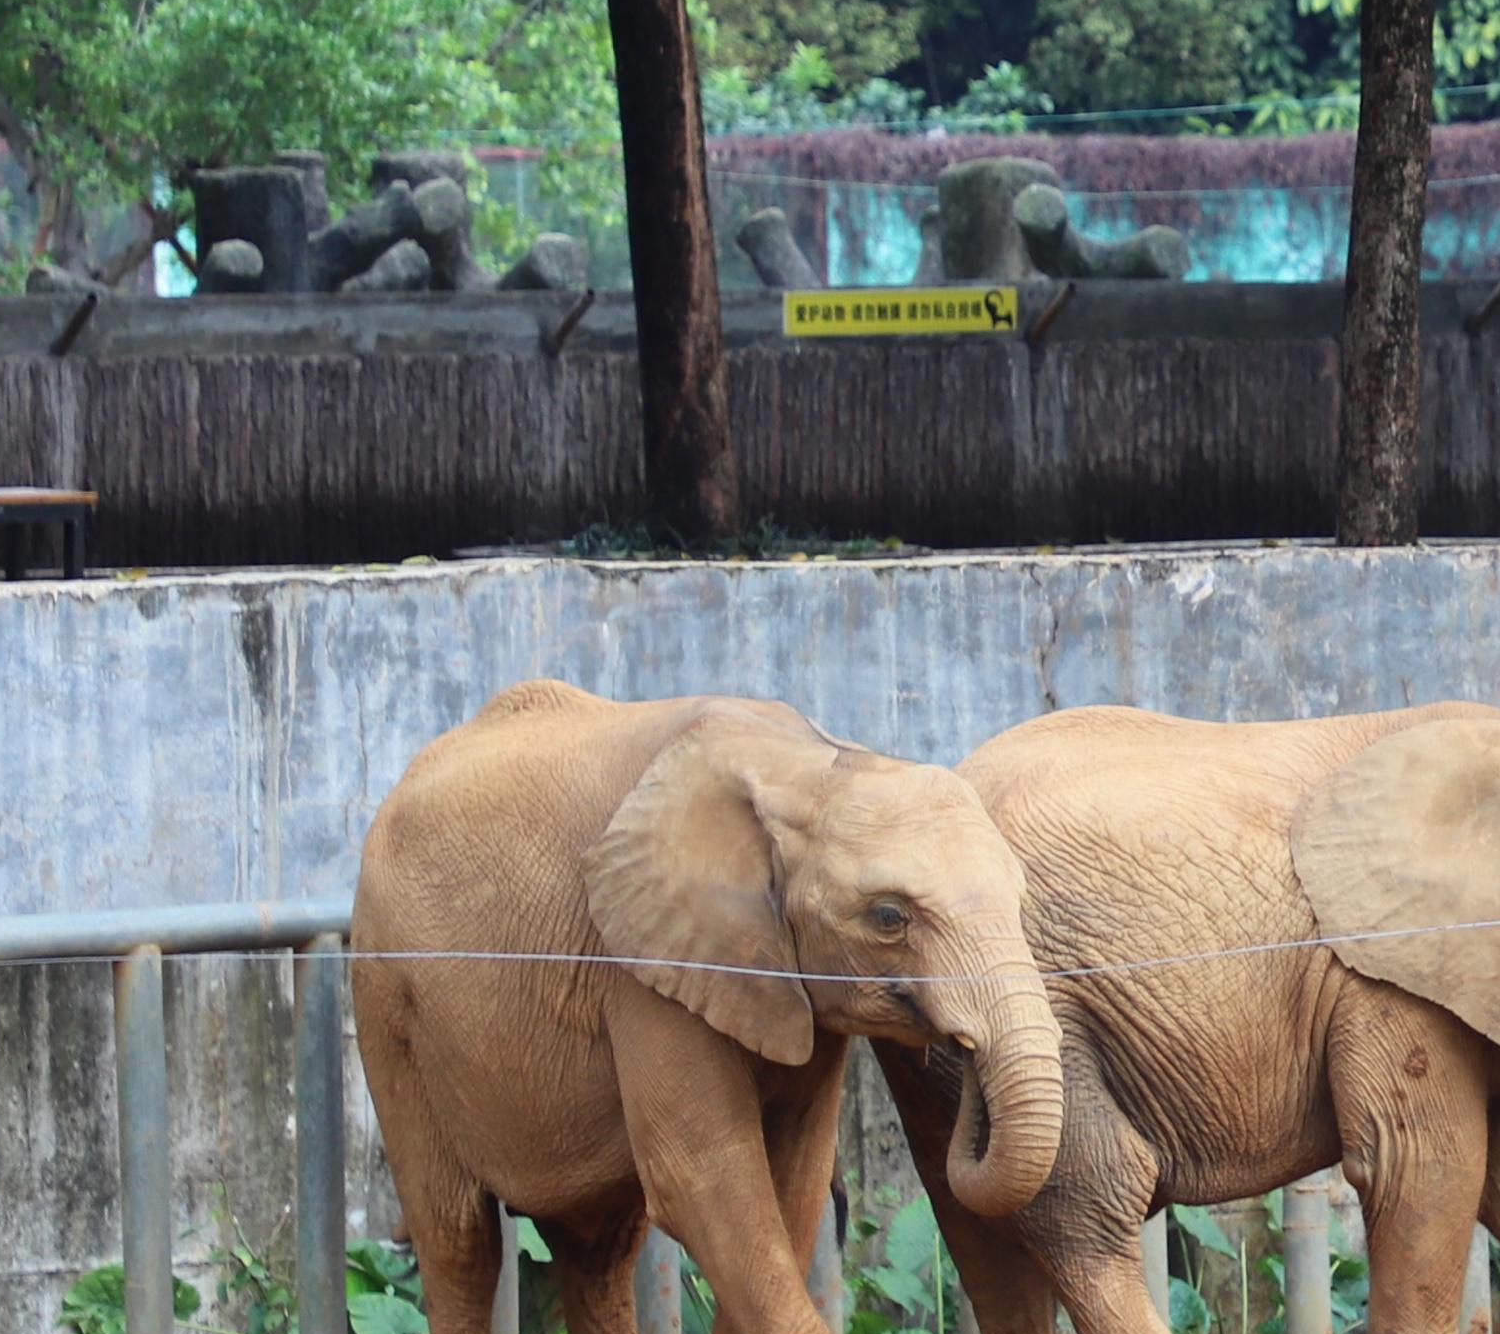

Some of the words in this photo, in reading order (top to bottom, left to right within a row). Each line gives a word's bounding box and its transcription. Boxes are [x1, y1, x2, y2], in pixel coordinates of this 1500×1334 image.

[796, 303, 846, 322] 爱护动物
[852, 302, 901, 321] 请勿触摸
[907, 300, 982, 321] 请勿私自投喂
